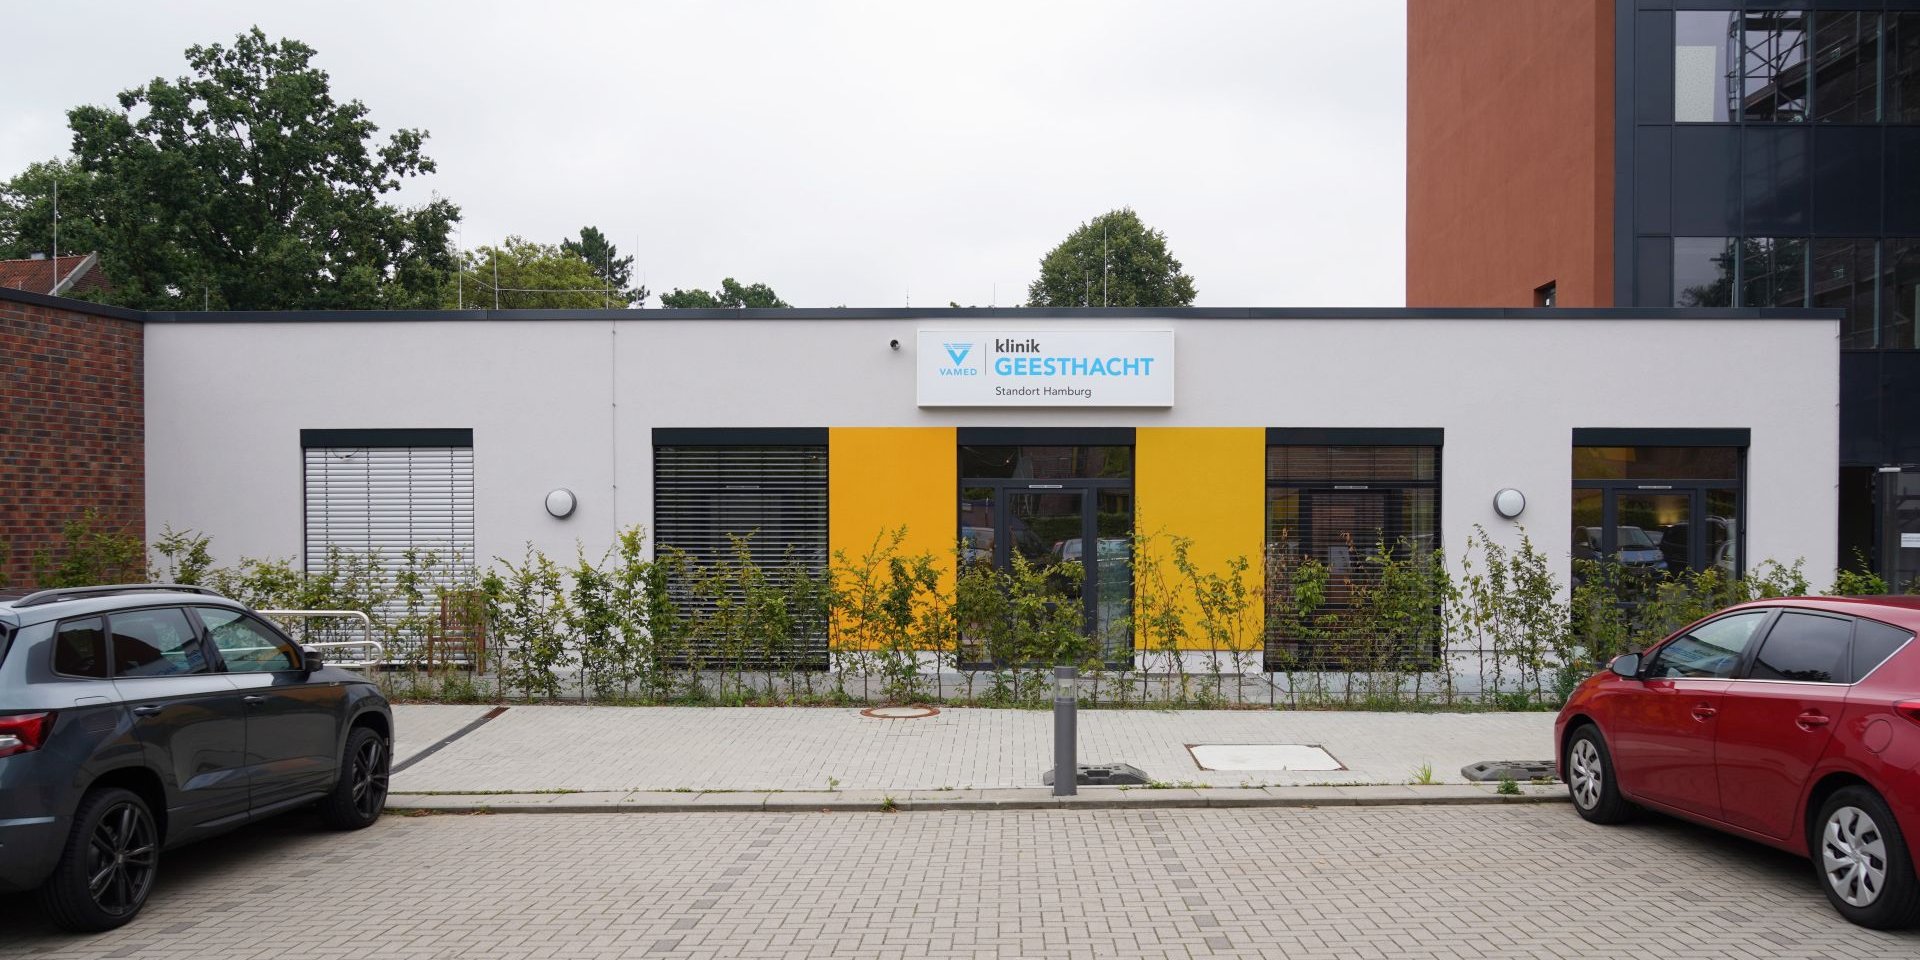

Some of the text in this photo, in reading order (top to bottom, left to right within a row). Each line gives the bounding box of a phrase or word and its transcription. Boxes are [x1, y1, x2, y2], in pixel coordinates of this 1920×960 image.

[995, 338, 1040, 353] klinik
[939, 368, 978, 376] VAMED
[994, 357, 1154, 377] GEESTHACHT
[995, 386, 1092, 399] Standort Hamburg
